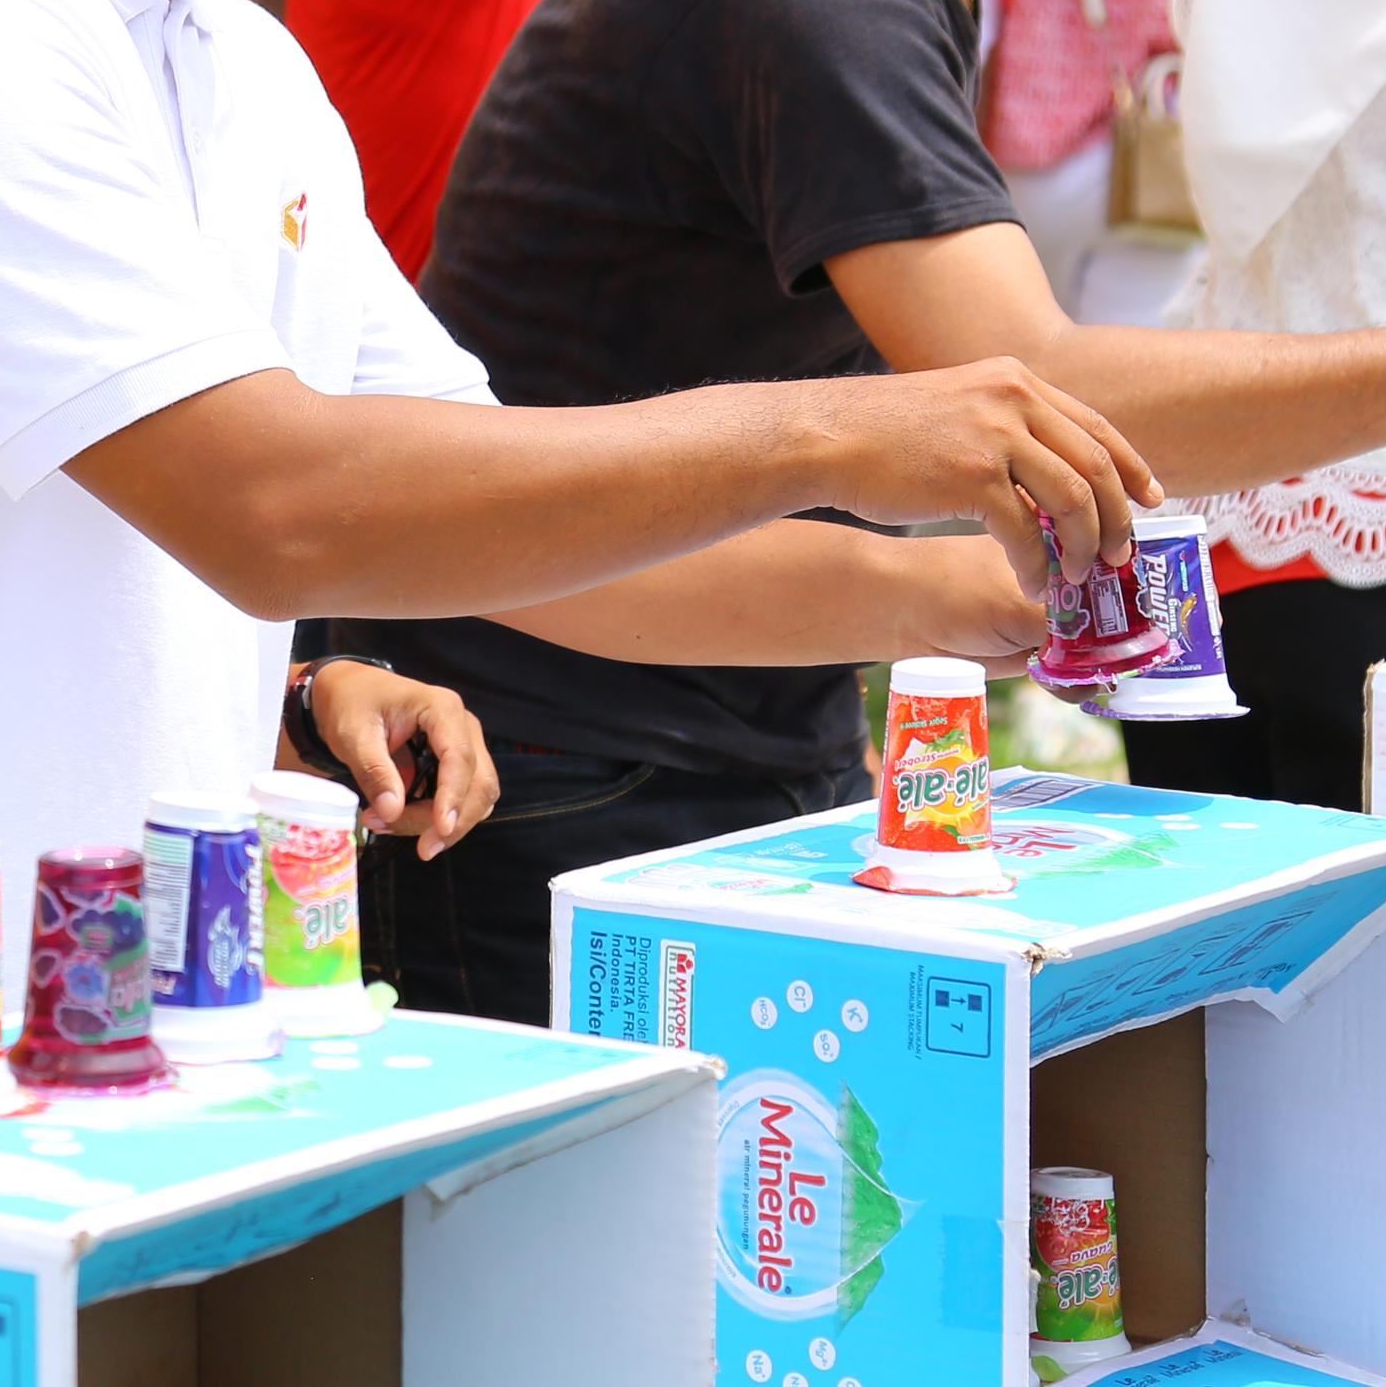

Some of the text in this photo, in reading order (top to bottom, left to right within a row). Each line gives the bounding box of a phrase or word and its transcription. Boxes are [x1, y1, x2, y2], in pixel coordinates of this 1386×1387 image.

[610, 933, 624, 1012] Indonesia.
[625, 936, 637, 955] PT
[624, 961, 636, 1006] TIRTA
[637, 937, 652, 1043] Diproduksi ole
[667, 952, 679, 1046] nutrition
[675, 978, 688, 1048] MAYORA
[951, 1022, 964, 1033] 7
[741, 1139, 752, 1250] air mineral pegunungan
[757, 1098, 794, 1293] Minerale
[788, 1171, 827, 1226] Le
